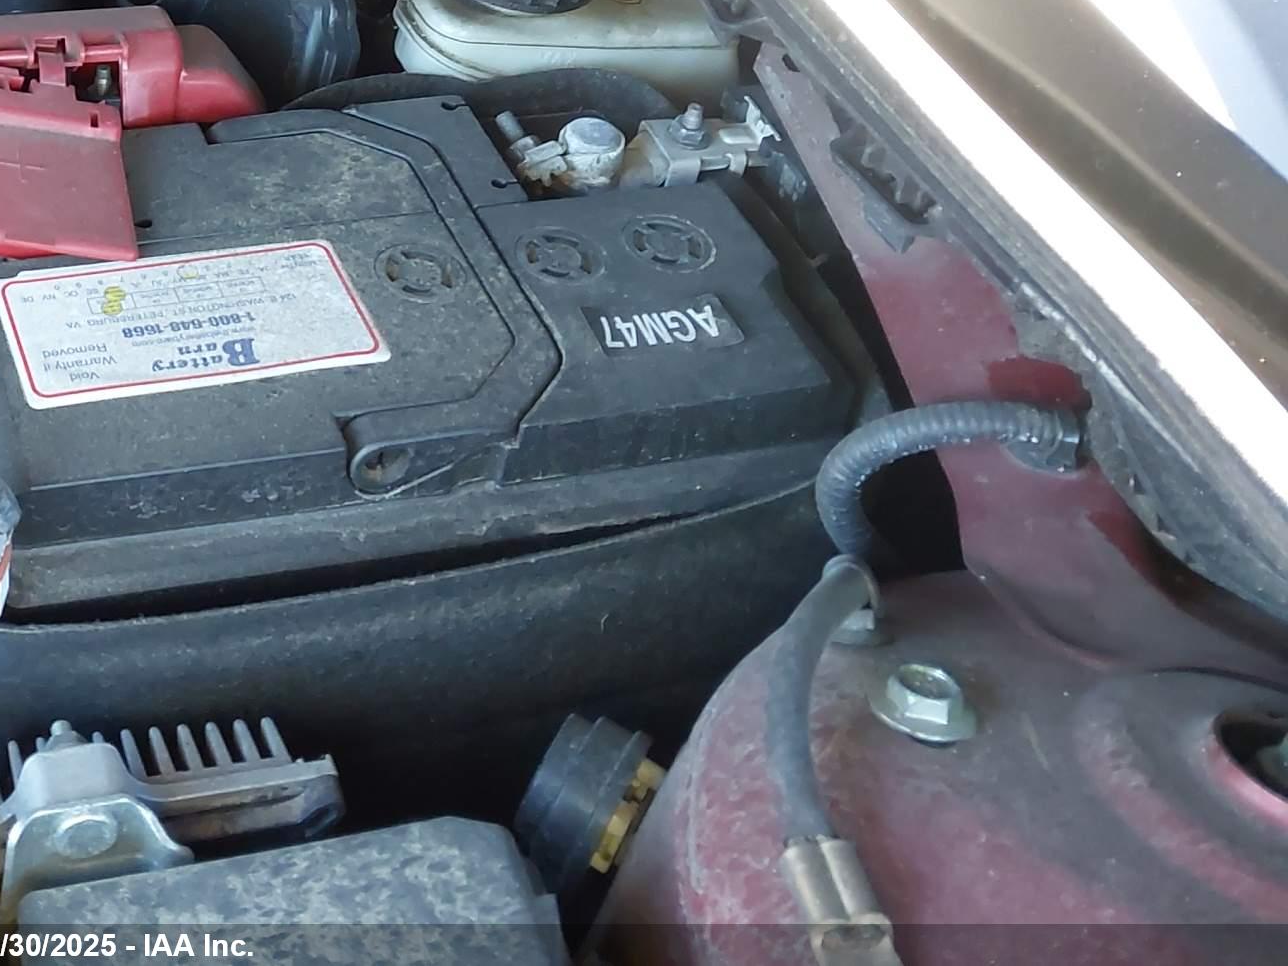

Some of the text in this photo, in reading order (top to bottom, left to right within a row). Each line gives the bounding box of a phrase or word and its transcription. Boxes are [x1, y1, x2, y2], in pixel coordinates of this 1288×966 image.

[599, 305, 720, 348] AGM47
[42, 343, 107, 360] Removed
[55, 355, 117, 373] Warranty
[69, 371, 100, 382] Void
